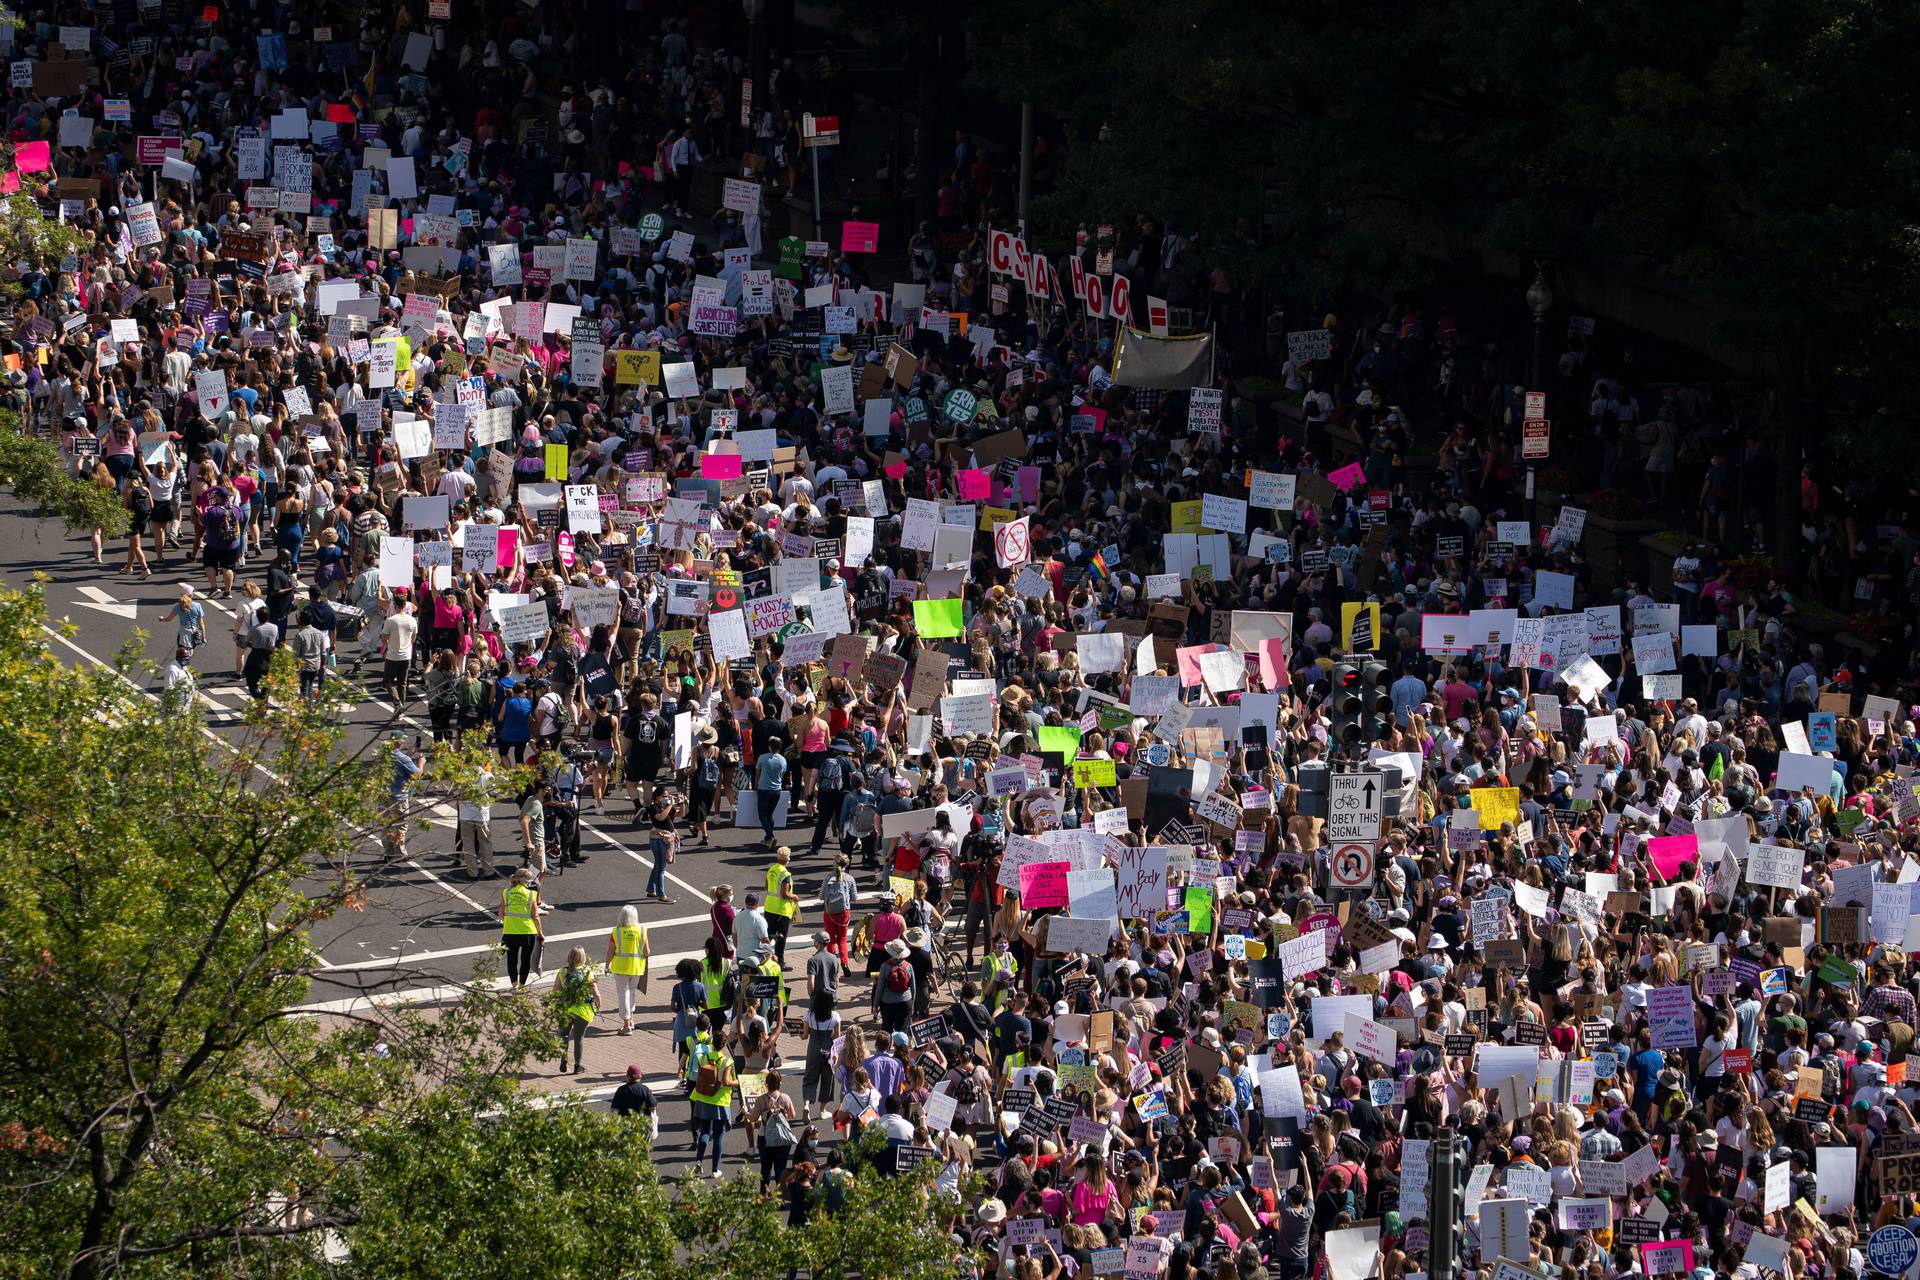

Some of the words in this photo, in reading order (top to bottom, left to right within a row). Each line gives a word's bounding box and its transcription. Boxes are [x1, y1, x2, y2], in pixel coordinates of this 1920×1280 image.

[642, 216, 660, 229] ERA
[640, 228, 660, 240] YES
[782, 246, 800, 254] MY
[500, 251, 520, 269] Body
[743, 274, 770, 286] Pro-Life
[696, 308, 736, 322] ABORTION
[744, 305, 772, 313] WOMAN
[694, 321, 718, 333] SAVES
[718, 322, 736, 335] LIVES
[950, 389, 976, 410] ERA
[906, 398, 925, 415] ERA
[945, 405, 973, 422] YES
[1195, 424, 1218, 432] SENATOR
[574, 498, 586, 506] THE
[1563, 508, 1586, 518] PROTECT
[754, 599, 782, 616] PUSSY
[856, 594, 884, 612] PROTECT
[752, 612, 790, 632] POWER
[1518, 620, 1540, 633] HER
[1516, 632, 1538, 644] BODY
[1518, 644, 1536, 654] HER
[1510, 654, 1536, 666] CHOICE
[1334, 778, 1358, 789] THRU
[1212, 807, 1228, 816] HER
[1332, 813, 1354, 824] OBEY
[1359, 812, 1378, 823] THIS
[1331, 826, 1362, 837] SIGNAL
[1122, 848, 1148, 868] MY
[1758, 847, 1772, 856] MY
[1776, 850, 1796, 862] BODY
[1752, 860, 1760, 869] IS
[1762, 861, 1776, 870] NOT
[1778, 864, 1800, 874] YOUR
[1138, 870, 1160, 892] Body
[1754, 871, 1794, 884] PROPERTY
[1120, 885, 1142, 904] MY
[1224, 916, 1250, 926] FREEDOM
[1310, 920, 1329, 930] KEEP
[1830, 920, 1856, 931] ACCESS
[1282, 948, 1318, 966] JUSTICE
[1283, 961, 1318, 978] NOW
[1359, 1029, 1378, 1040] RIGHT
[1664, 1028, 1693, 1037] yours?
[1726, 1060, 1746, 1068] ywca
[1572, 1094, 1592, 1102] BLM
[1029, 1108, 1041, 1118] YOUR
[1042, 1114, 1055, 1125] REASON
[1876, 1228, 1907, 1242] KEEP
[1129, 1239, 1160, 1254] ABORTION
[1870, 1241, 1916, 1256] ABORTION
[1876, 1254, 1912, 1267] LEGAL
[1126, 1270, 1158, 1280] HEALTHCARE
[1658, 1265, 1674, 1273] BODY
